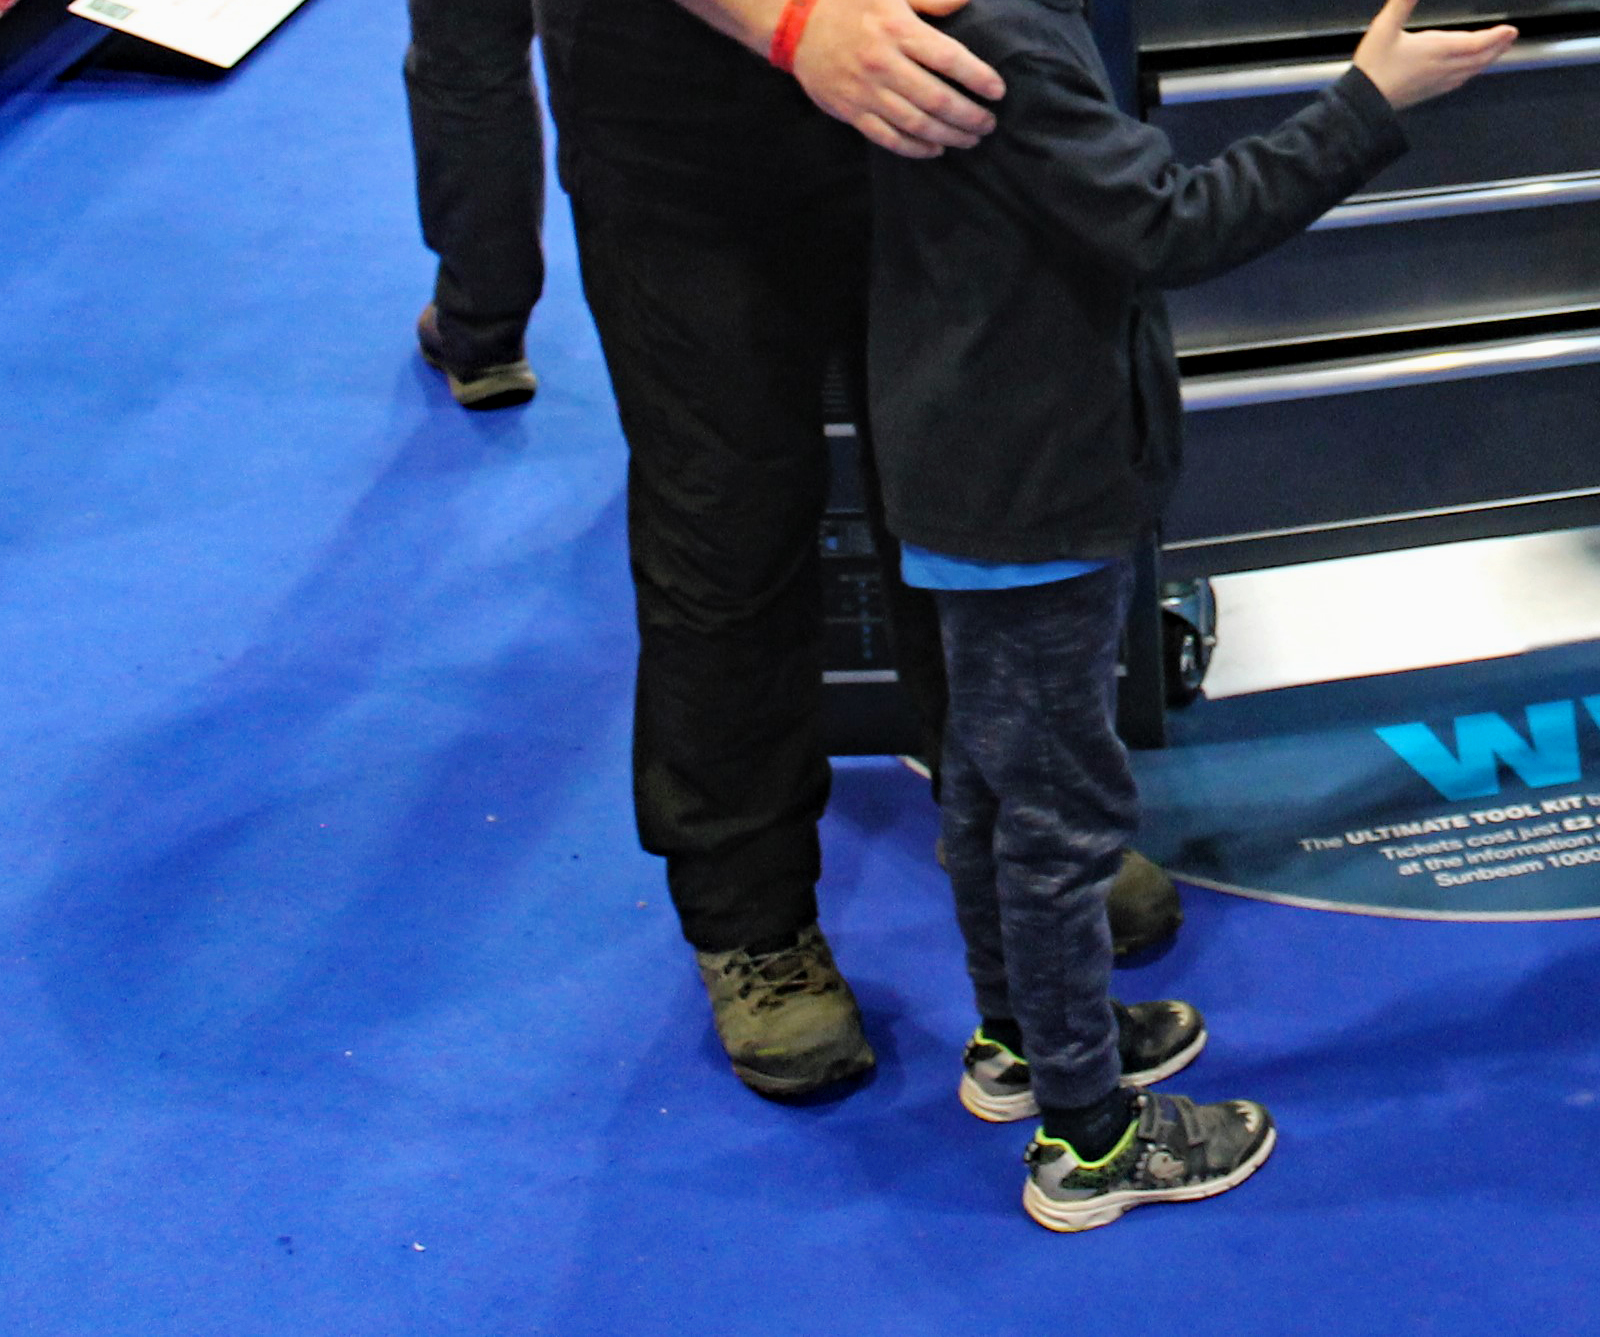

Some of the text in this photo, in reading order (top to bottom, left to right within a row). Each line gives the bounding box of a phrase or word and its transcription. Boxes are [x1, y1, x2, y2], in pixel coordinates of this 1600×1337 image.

[1300, 834, 1343, 853] The
[1345, 814, 1471, 846] ULTIMATE
[1469, 803, 1541, 825] TOOL
[1540, 794, 1584, 814] KIT
[1380, 837, 1464, 861] Tickets
[1466, 826, 1517, 848] cost
[1517, 821, 1561, 842] just
[1399, 861, 1424, 877] at
[1424, 854, 1463, 872] the
[1464, 833, 1594, 865] information
[1434, 859, 1546, 889] Sunbeam
